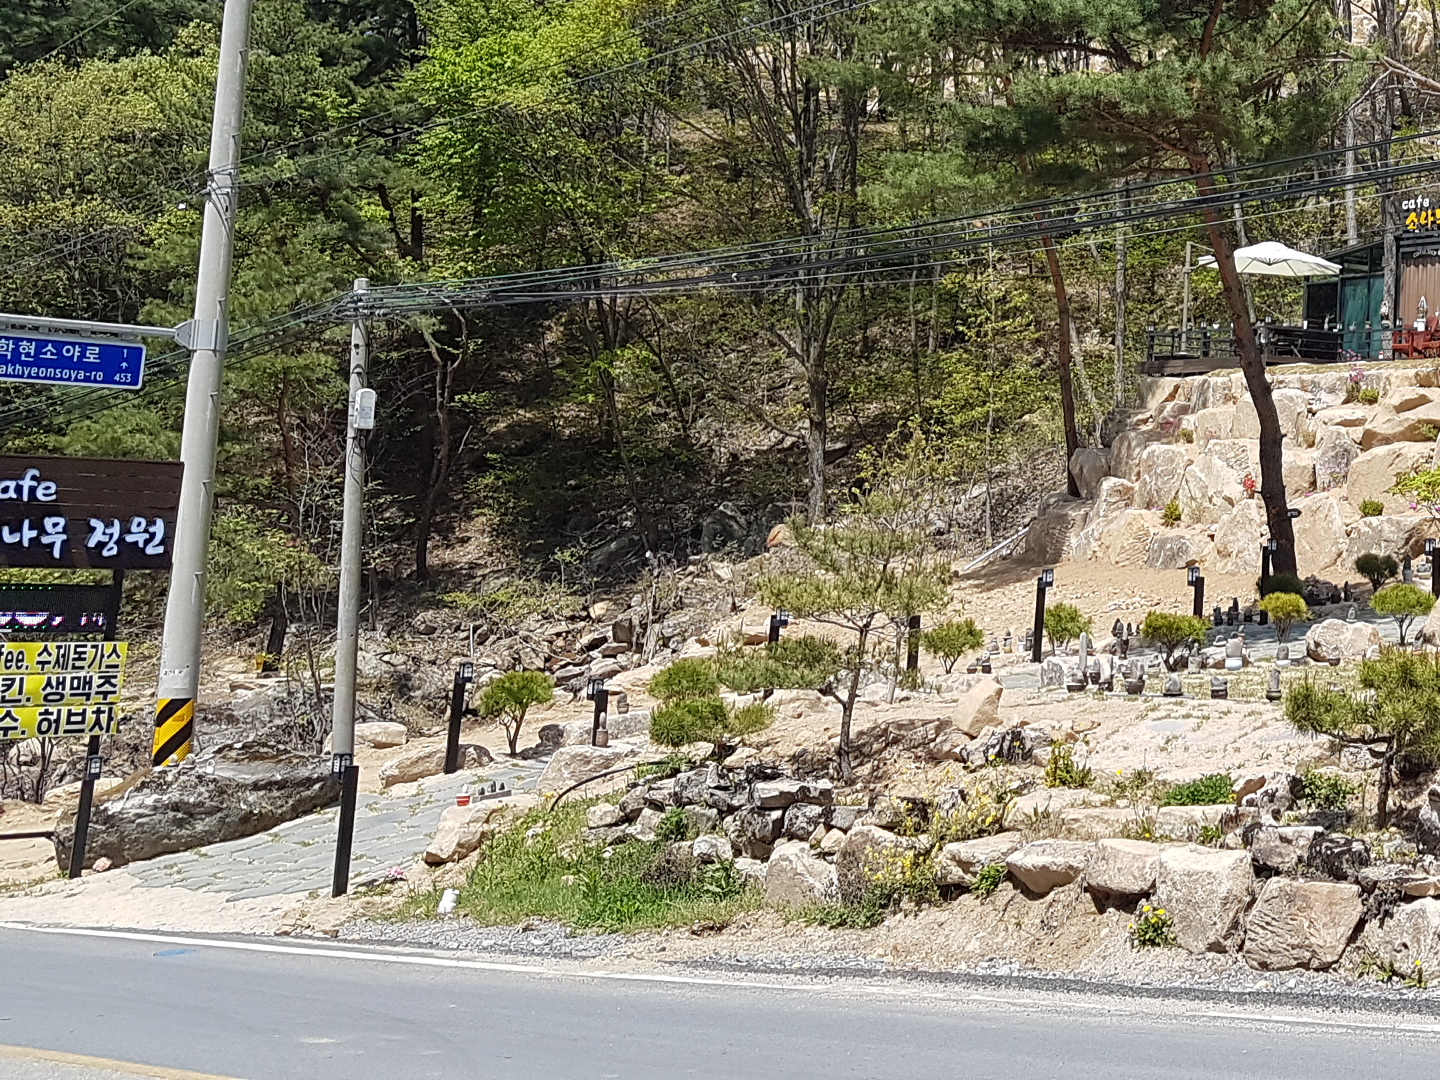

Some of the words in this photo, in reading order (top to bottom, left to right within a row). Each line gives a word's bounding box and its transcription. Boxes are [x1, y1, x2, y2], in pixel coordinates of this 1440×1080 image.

[1402, 195, 1430, 210] cafe
[0, 338, 101, 363] 학현소야로
[123, 349, 128, 359] 1
[113, 373, 132, 383] 453
[2, 516, 68, 560] 나무
[86, 516, 165, 558] 정원
[35, 644, 122, 672] 수제돈가스
[42, 675, 118, 704] 생맥주
[36, 707, 115, 736] 허브차
